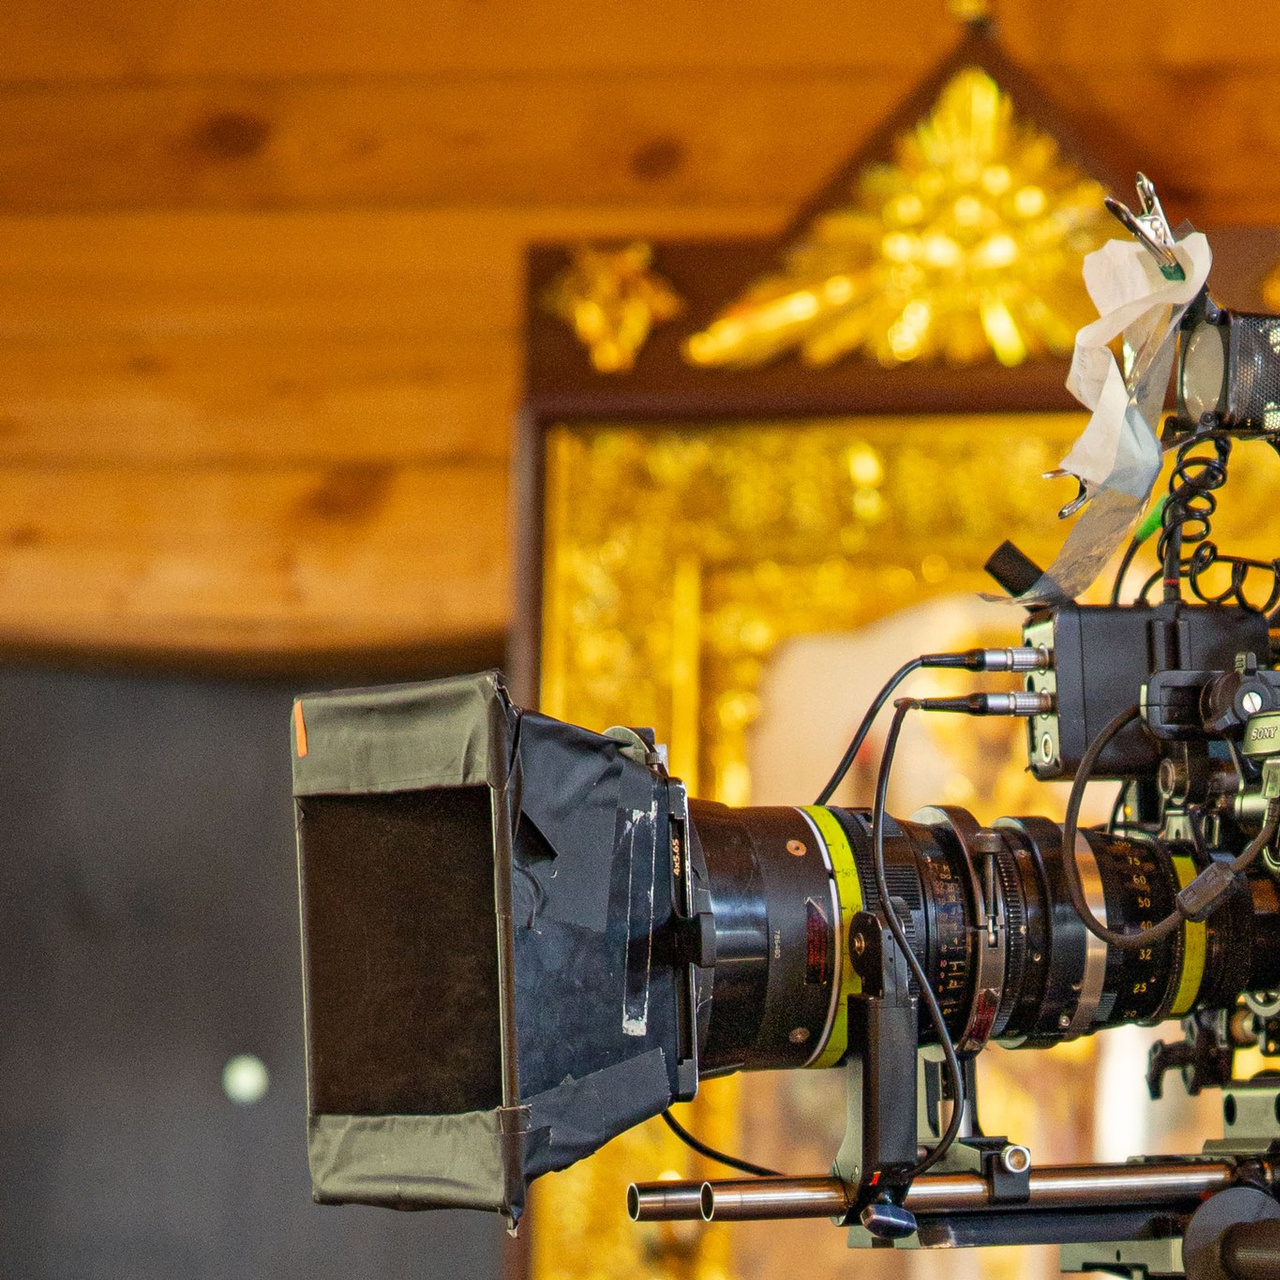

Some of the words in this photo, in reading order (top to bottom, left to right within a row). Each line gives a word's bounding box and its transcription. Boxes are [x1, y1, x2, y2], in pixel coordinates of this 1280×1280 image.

[1251, 726, 1278, 741] SONY
[672, 838, 680, 876] 4x5.65
[1133, 874, 1147, 885] 60
[1138, 897, 1151, 908] 50
[1140, 949, 1152, 960] 32
[1132, 983, 1147, 994] 25
